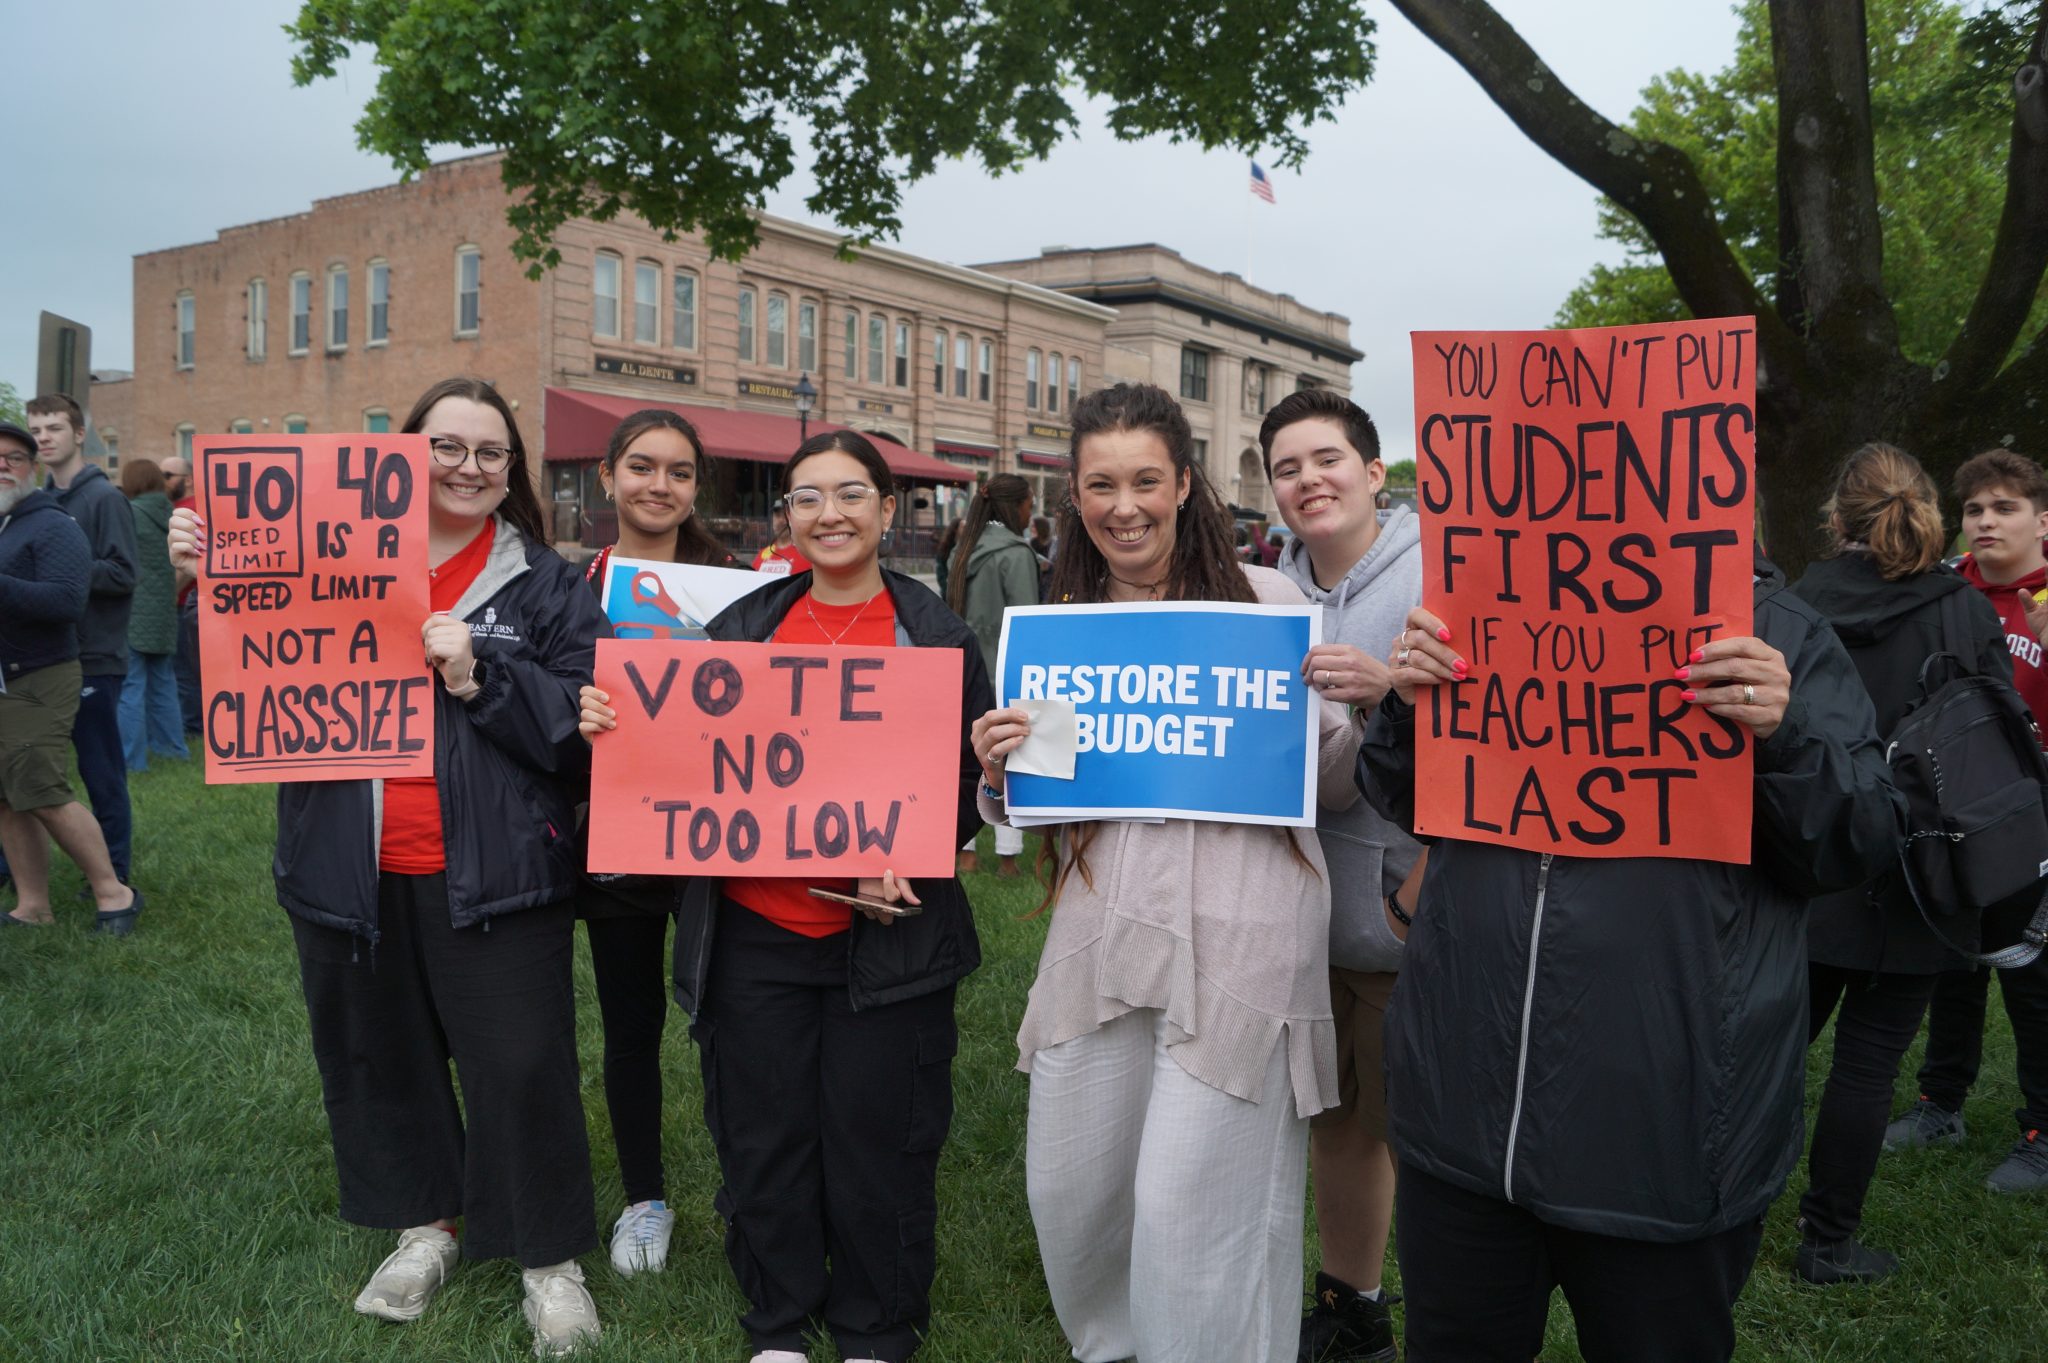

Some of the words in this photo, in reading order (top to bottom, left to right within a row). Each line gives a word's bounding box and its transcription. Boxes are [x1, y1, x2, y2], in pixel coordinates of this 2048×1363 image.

[620, 362, 636, 375] AL
[638, 365, 674, 381] DENTE
[1434, 341, 1498, 400] YOU
[1519, 335, 1665, 409] CAN'T
[1676, 329, 1753, 399] PUT
[338, 446, 413, 519] 40
[1421, 402, 1754, 524] STUDENTS
[215, 461, 295, 522] 40
[216, 527, 280, 550] SPEED
[221, 550, 288, 570] LIMIT
[317, 521, 353, 560] IS
[377, 524, 400, 559] A
[213, 580, 293, 615] SPEED
[312, 573, 397, 602] LIMIT
[1444, 525, 1738, 616] FIRST
[242, 628, 336, 670] NOT
[350, 619, 378, 664] A
[1471, 616, 1502, 665] IF
[1523, 621, 1605, 673] YOU
[1640, 624, 1723, 673] PUT
[2004, 632, 2042, 668] ORD
[624, 657, 885, 722] VOTE
[1019, 664, 1200, 704] RESTORE
[1211, 666, 1291, 711] THE
[1074, 713, 1234, 758] BUDGET
[1464, 754, 1698, 846] LAST
